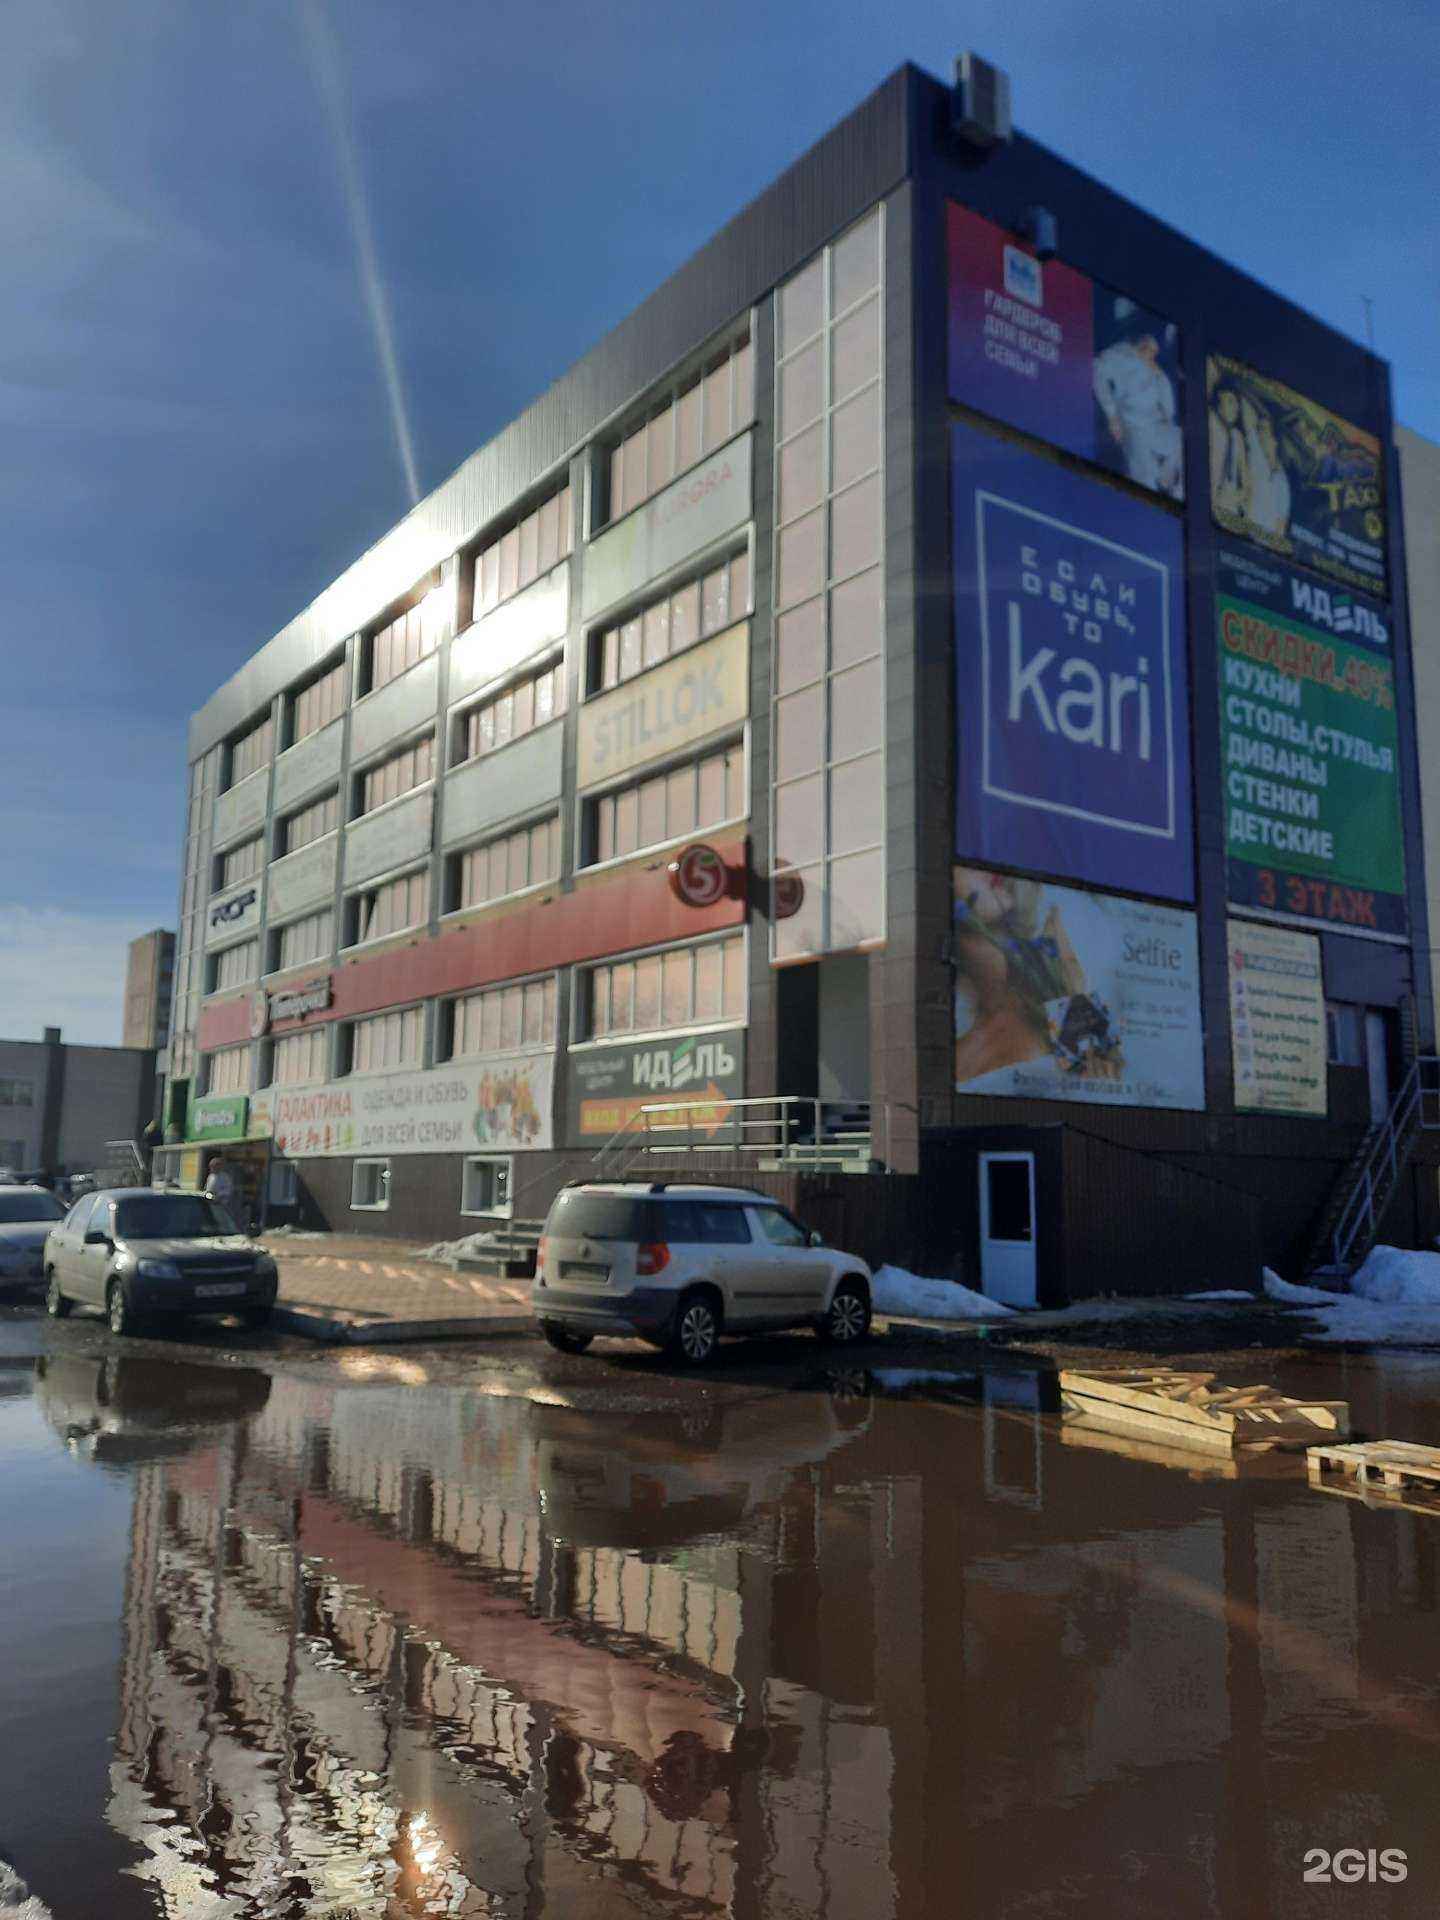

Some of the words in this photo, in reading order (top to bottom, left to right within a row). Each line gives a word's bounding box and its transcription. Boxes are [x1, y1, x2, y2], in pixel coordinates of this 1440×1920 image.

[1061, 610, 1103, 645] ТО
[1007, 600, 1150, 761] kari
[1225, 656, 1301, 709] КУХНИ
[1227, 731, 1328, 788] ДИВАНЫ
[1227, 770, 1320, 821] СТЕНКИ
[1229, 806, 1335, 861] ДЕТСКИЕ
[1258, 869, 1276, 906] 3
[1287, 875, 1377, 928] ЭТАЖ
[1121, 932, 1182, 971] Selfie
